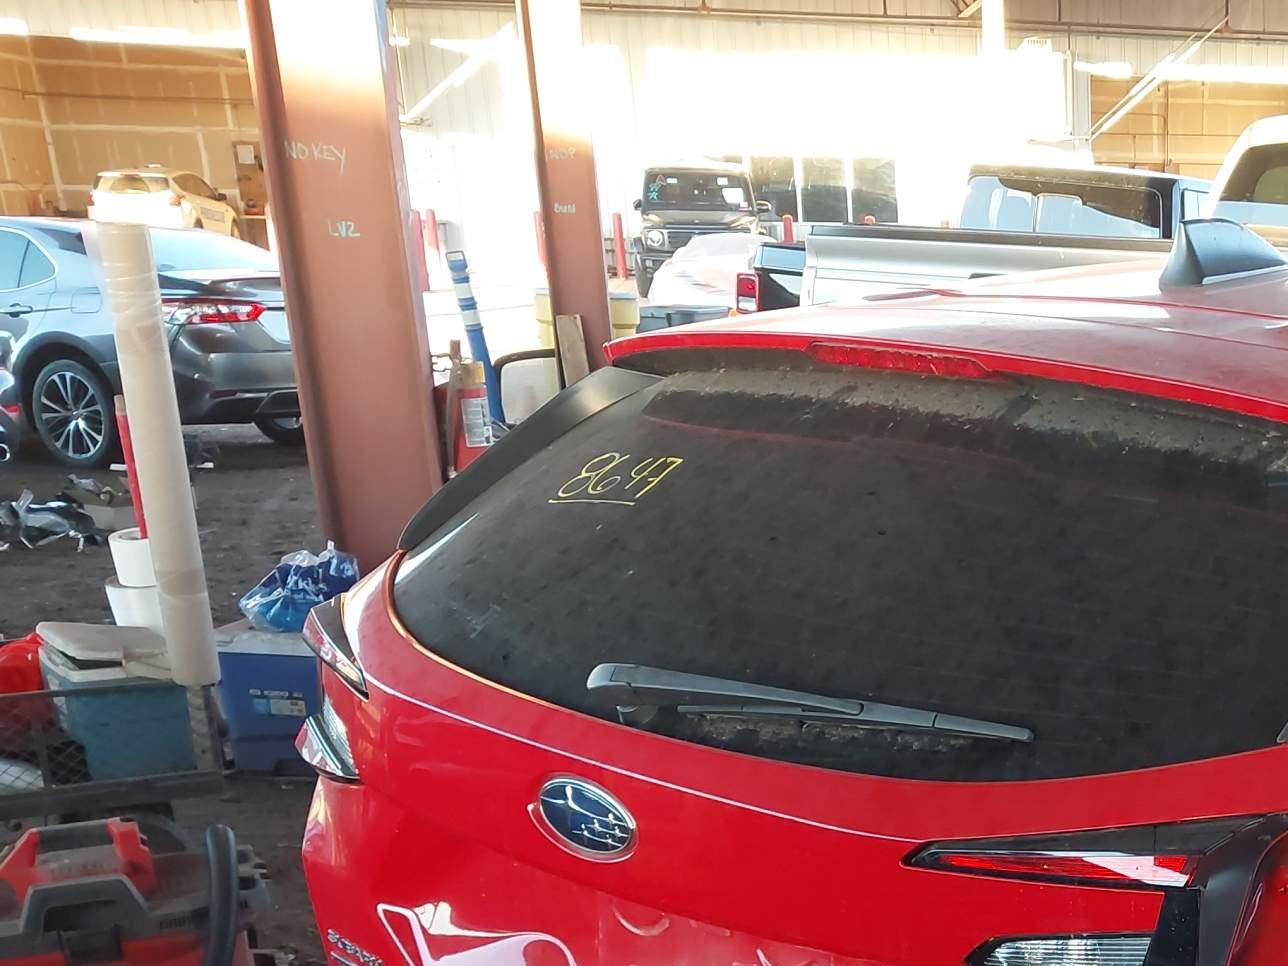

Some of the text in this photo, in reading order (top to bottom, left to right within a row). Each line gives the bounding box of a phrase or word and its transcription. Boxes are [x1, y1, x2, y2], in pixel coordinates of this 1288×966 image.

[284, 141, 346, 176] NO KEY
[558, 452, 684, 499] 8647
